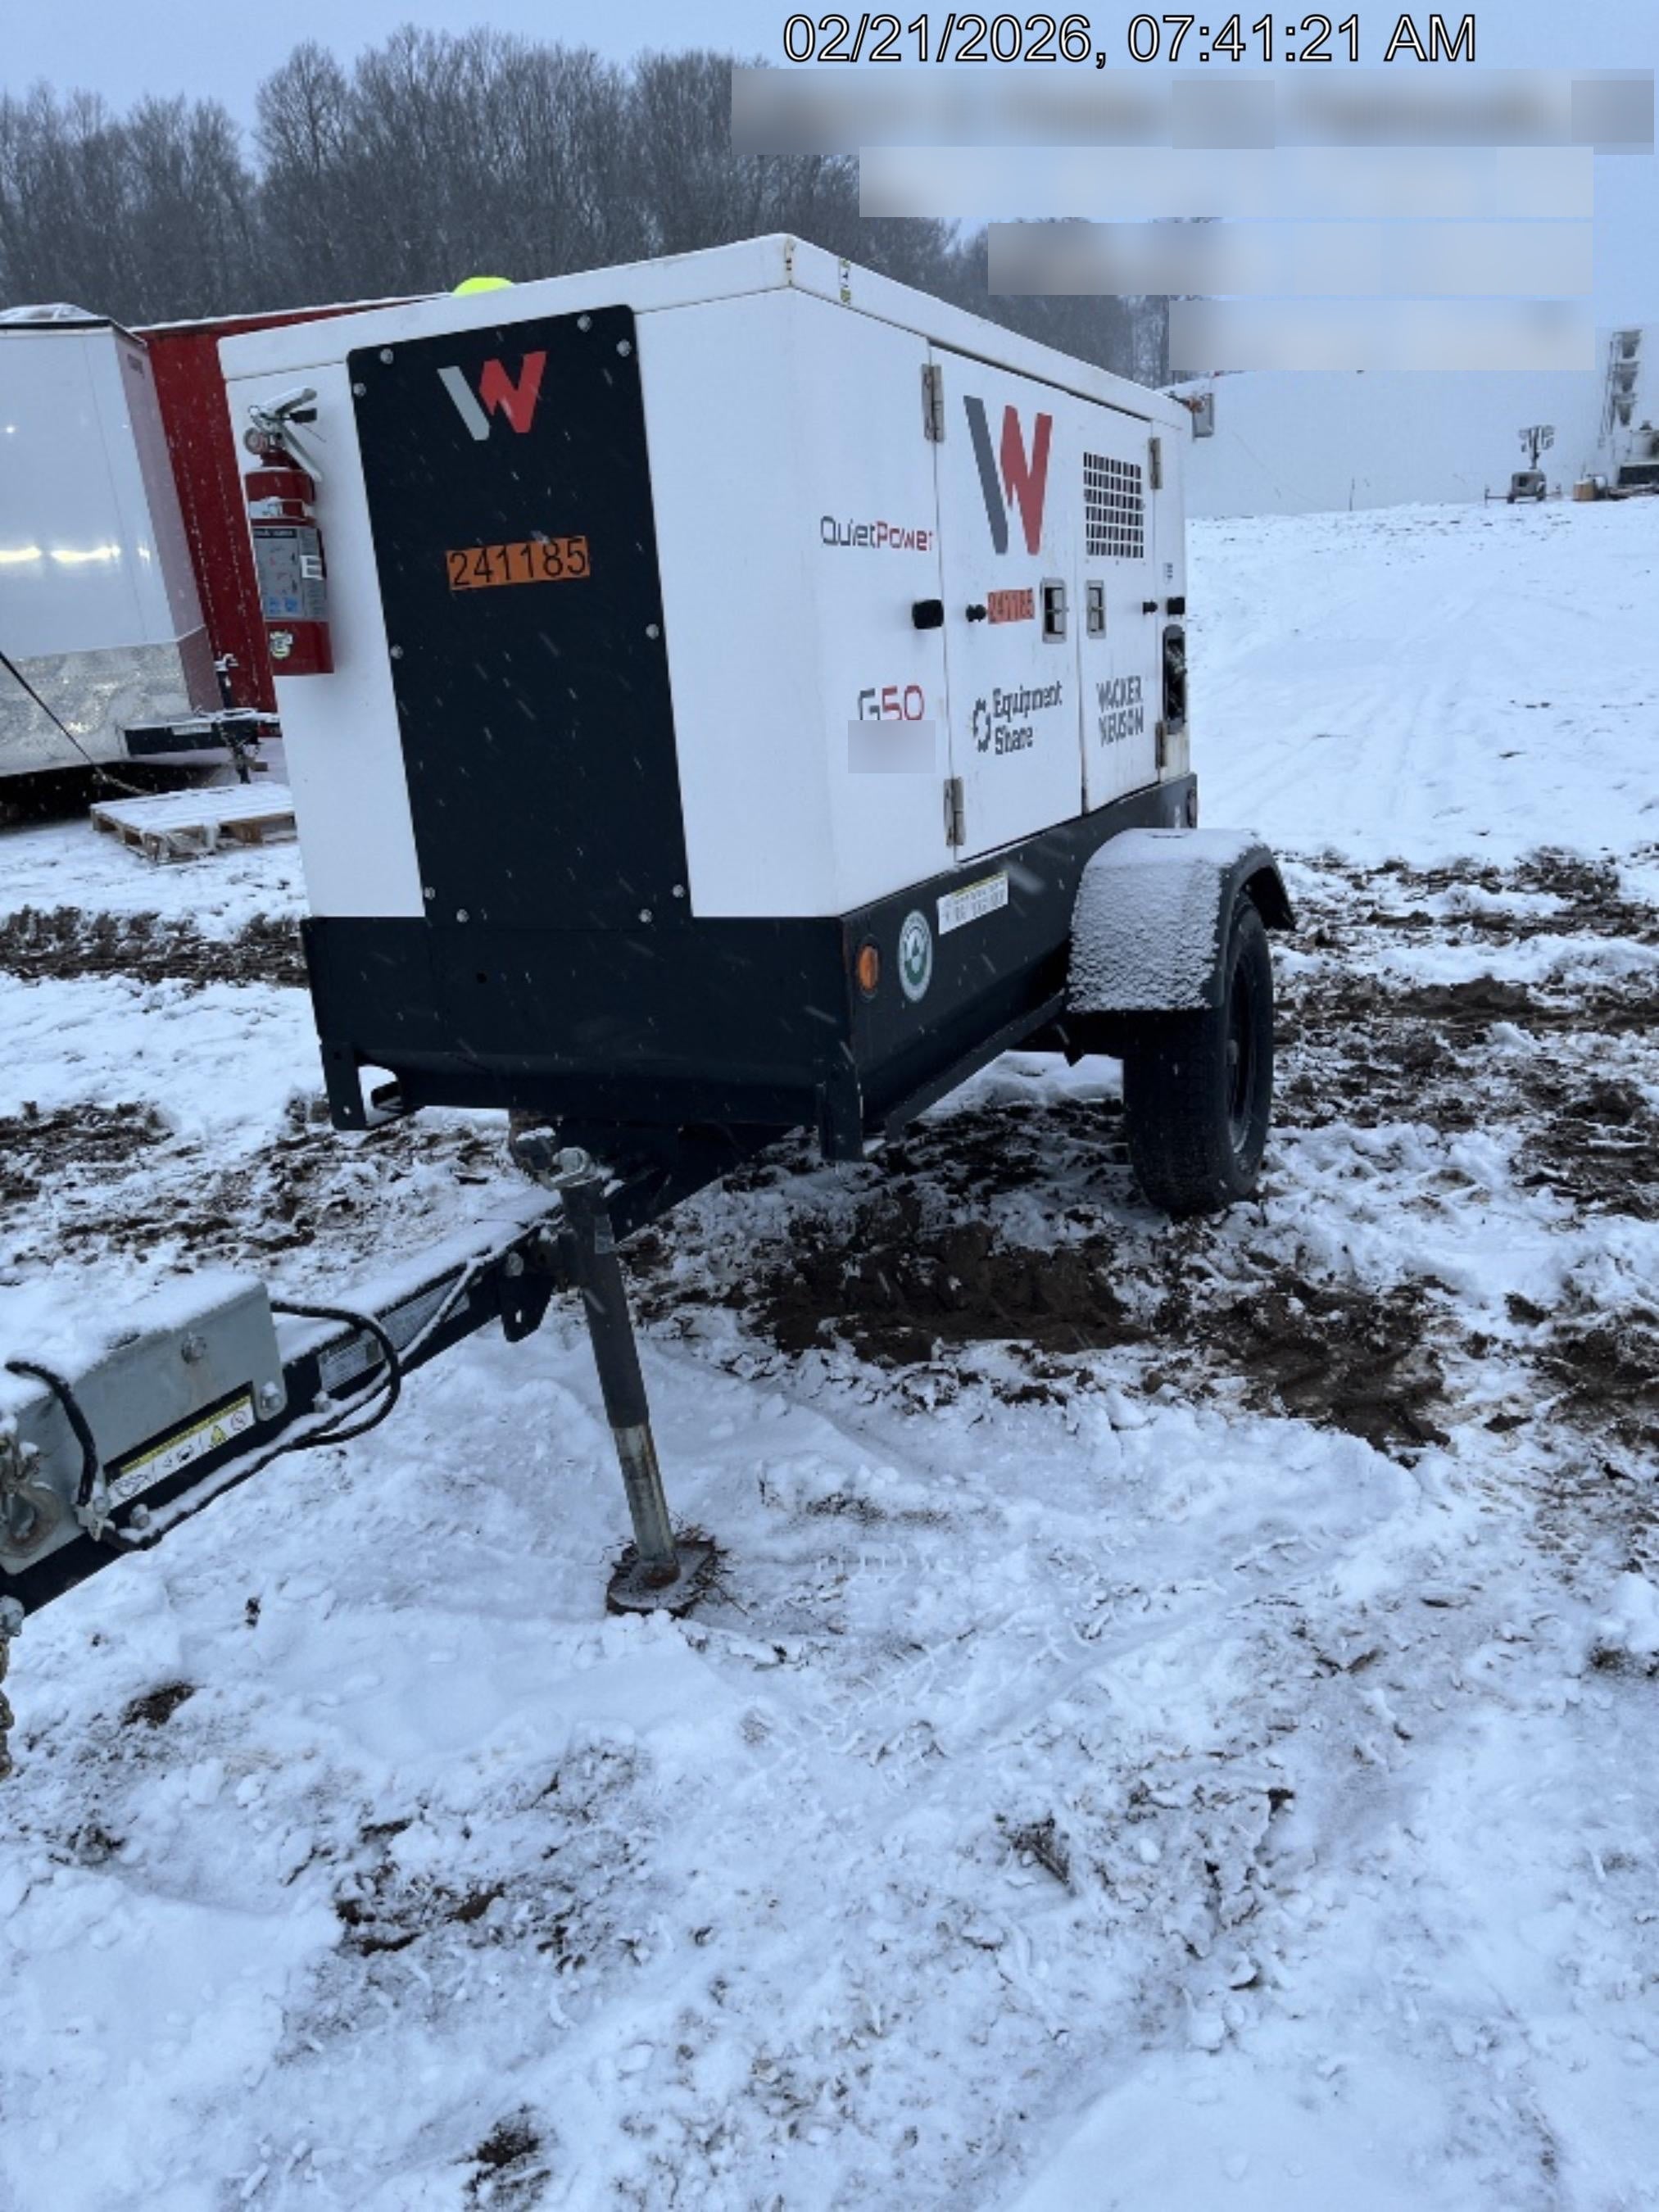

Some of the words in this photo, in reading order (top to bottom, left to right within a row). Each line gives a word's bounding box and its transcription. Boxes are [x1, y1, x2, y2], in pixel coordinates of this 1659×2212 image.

[820, 515, 933, 551] QuietPower
[450, 537, 586, 587] 241185
[858, 685, 925, 721] G50
[993, 680, 1063, 723] Equipment
[995, 724, 1033, 755] Share
